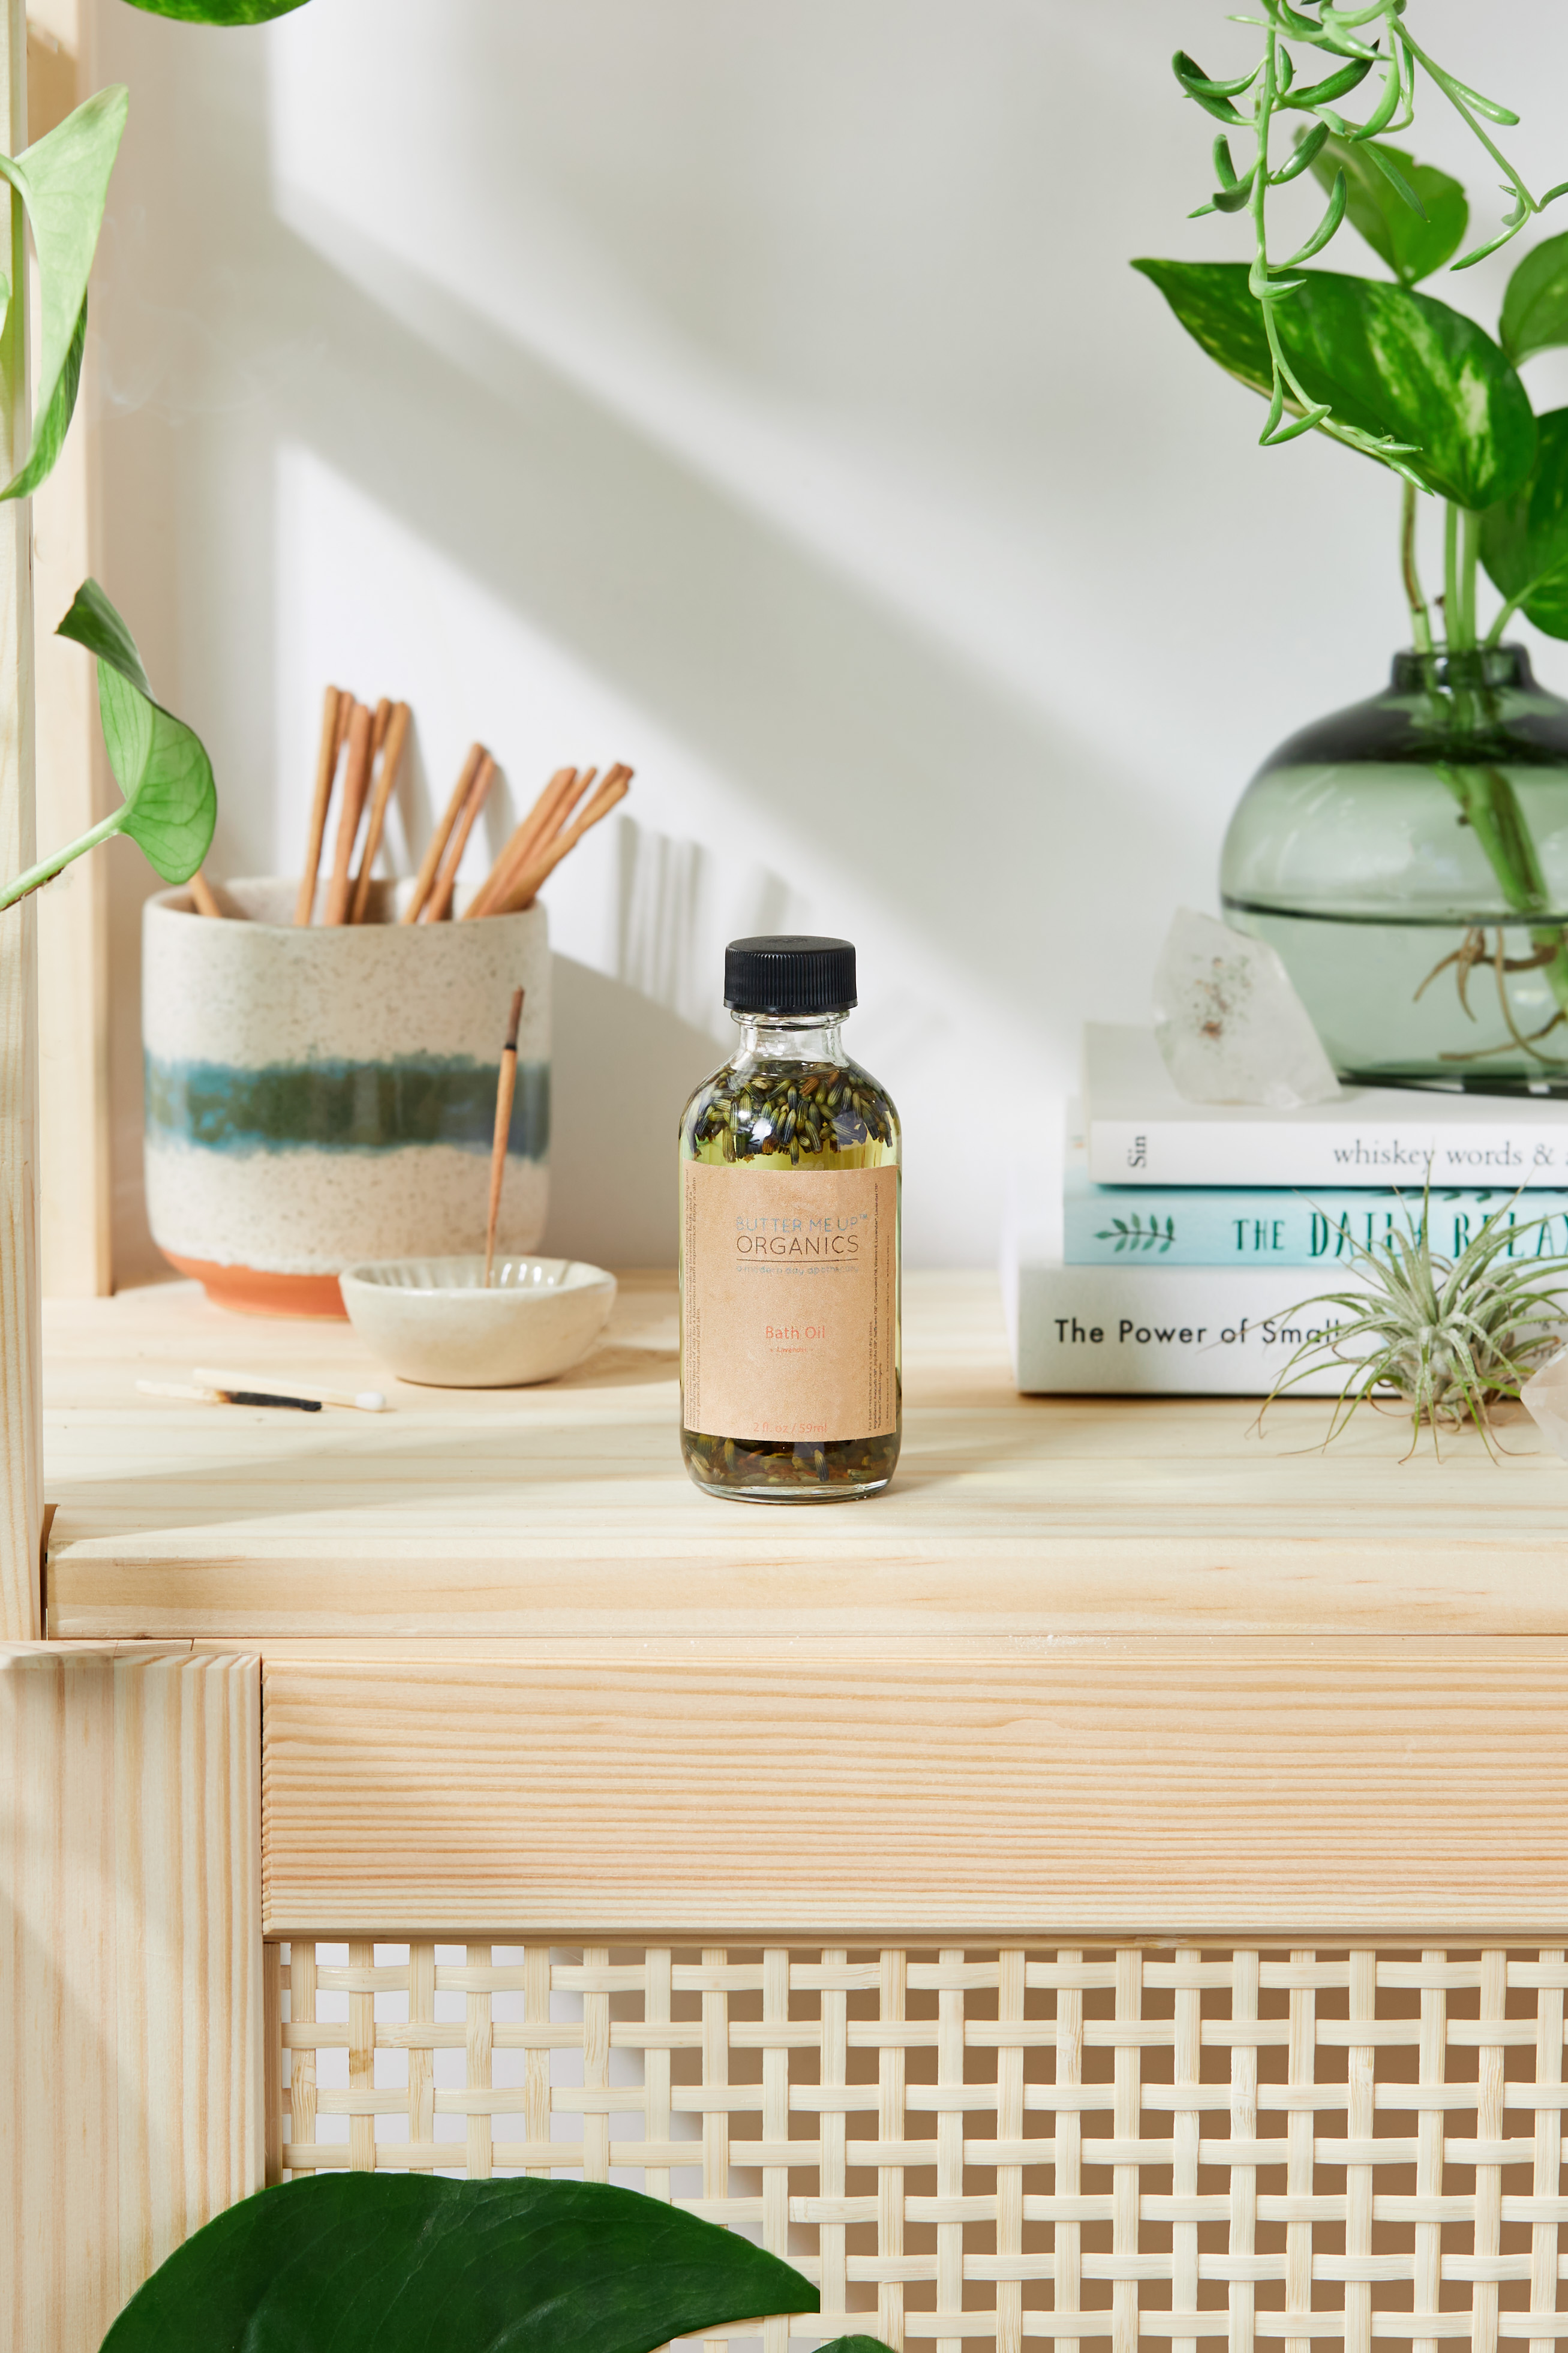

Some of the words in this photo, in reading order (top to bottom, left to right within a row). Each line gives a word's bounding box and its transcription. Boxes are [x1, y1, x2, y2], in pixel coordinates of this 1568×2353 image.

[1127, 1135, 1146, 1168] Sin
[1333, 1139, 1435, 1175] whiskey
[1446, 1141, 1524, 1166] words
[1533, 1143, 1555, 1166] &
[736, 1216, 802, 1233] BUTTER
[809, 1218, 833, 1232] ME
[1232, 1219, 1286, 1251] THE
[1453, 1211, 1568, 1258] RLA
[737, 1234, 859, 1255] ORGANICS
[765, 1325, 800, 1339] Bath
[804, 1325, 825, 1339] Oil
[1054, 1317, 1104, 1344] The
[1119, 1318, 1207, 1344] Power
[1220, 1318, 1248, 1344] of
[1262, 1318, 1339, 1344] Small
[753, 1422, 759, 1432] 2
[774, 1425, 789, 1434] oz
